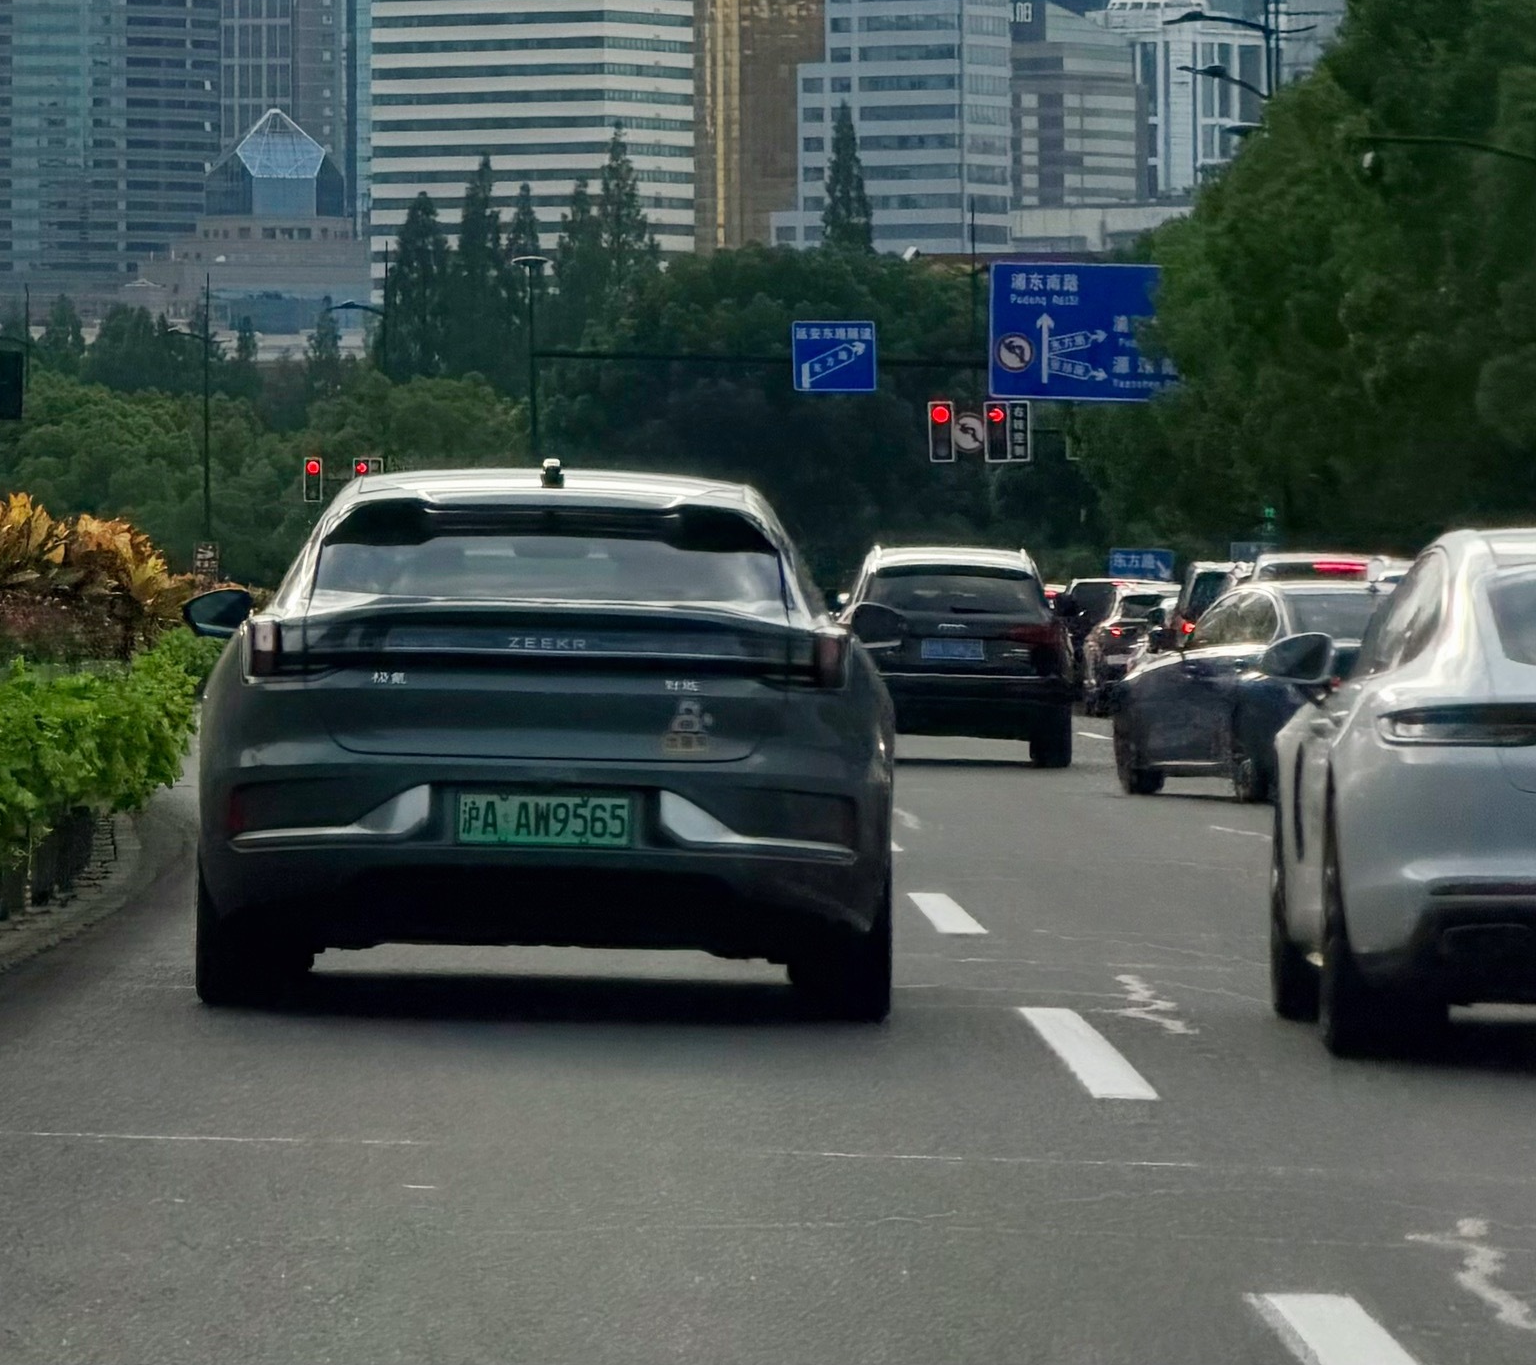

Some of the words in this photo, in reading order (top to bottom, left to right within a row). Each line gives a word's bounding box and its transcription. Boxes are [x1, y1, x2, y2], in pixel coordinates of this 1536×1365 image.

[1011, 273, 1078, 292] 浦东南路
[508, 636, 586, 650] ZEEKR
